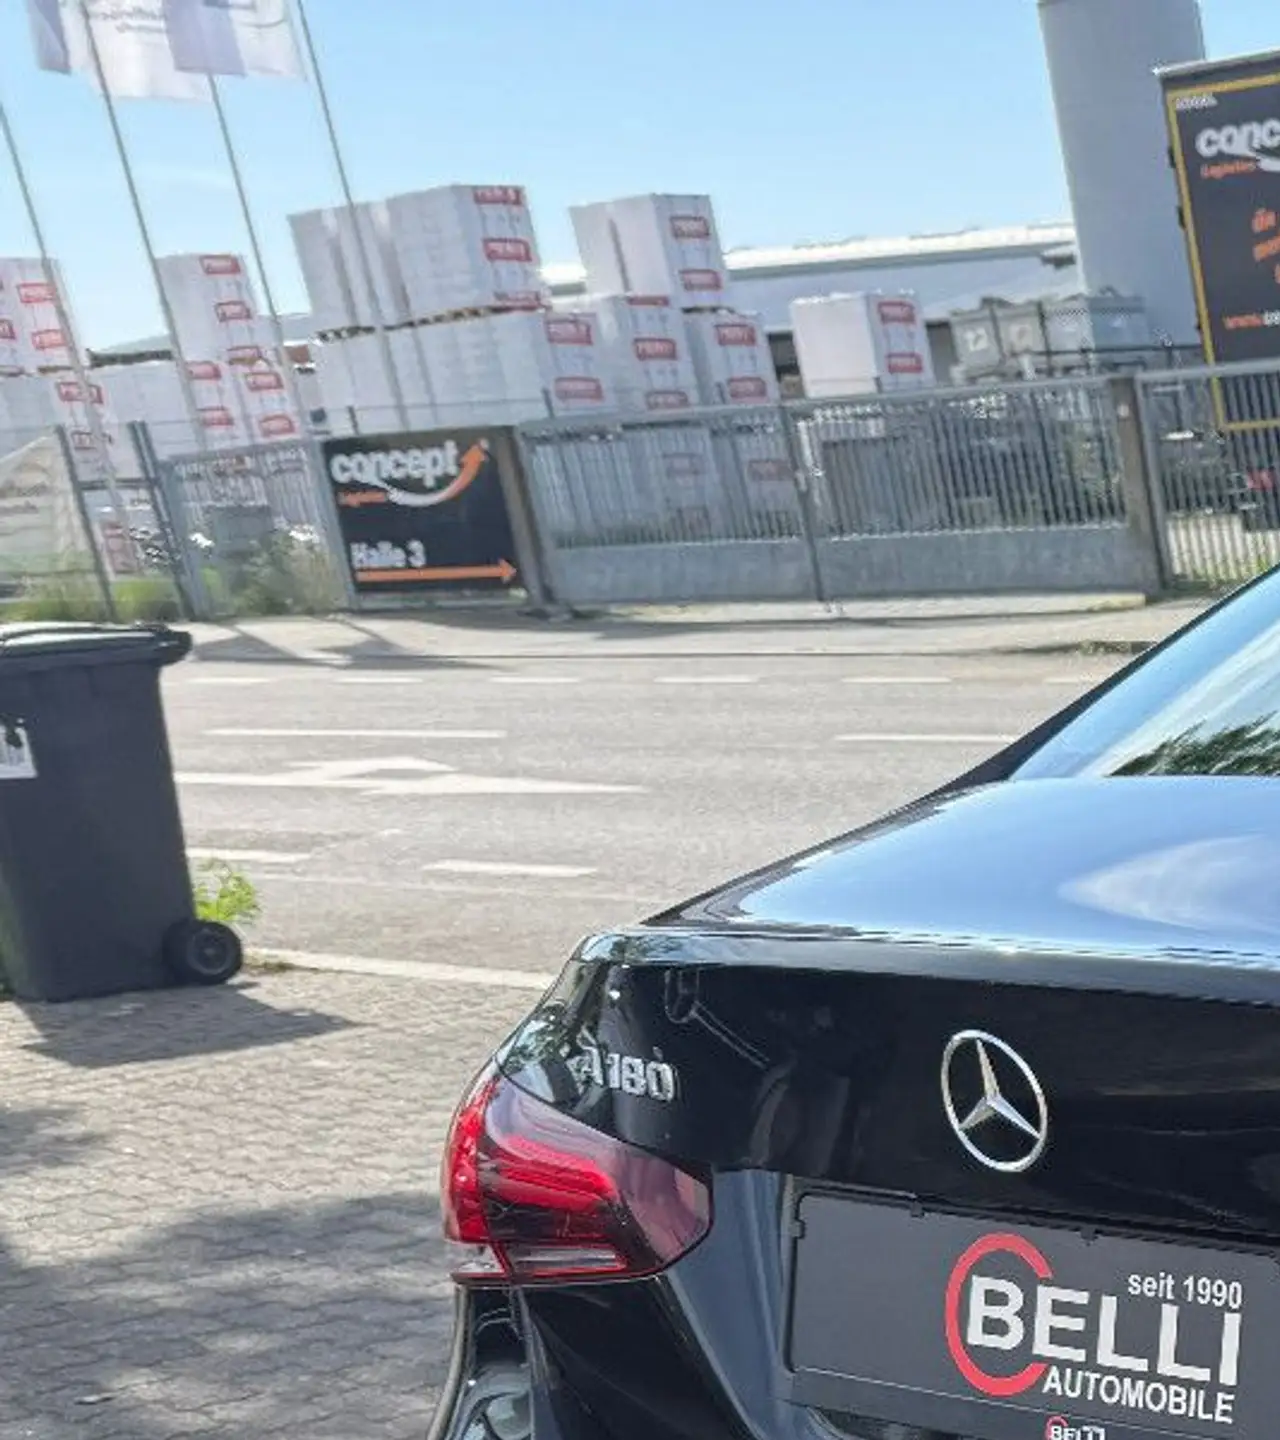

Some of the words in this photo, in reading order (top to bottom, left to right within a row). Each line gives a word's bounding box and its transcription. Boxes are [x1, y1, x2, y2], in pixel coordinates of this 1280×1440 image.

[330, 439, 459, 488] concept
[407, 539, 427, 568] 3
[1127, 1272, 1175, 1300] seit
[1183, 1275, 1242, 1310] 1990
[967, 1274, 1242, 1387] BELLI
[1042, 1365, 1236, 1424] AUTOMOBILE
